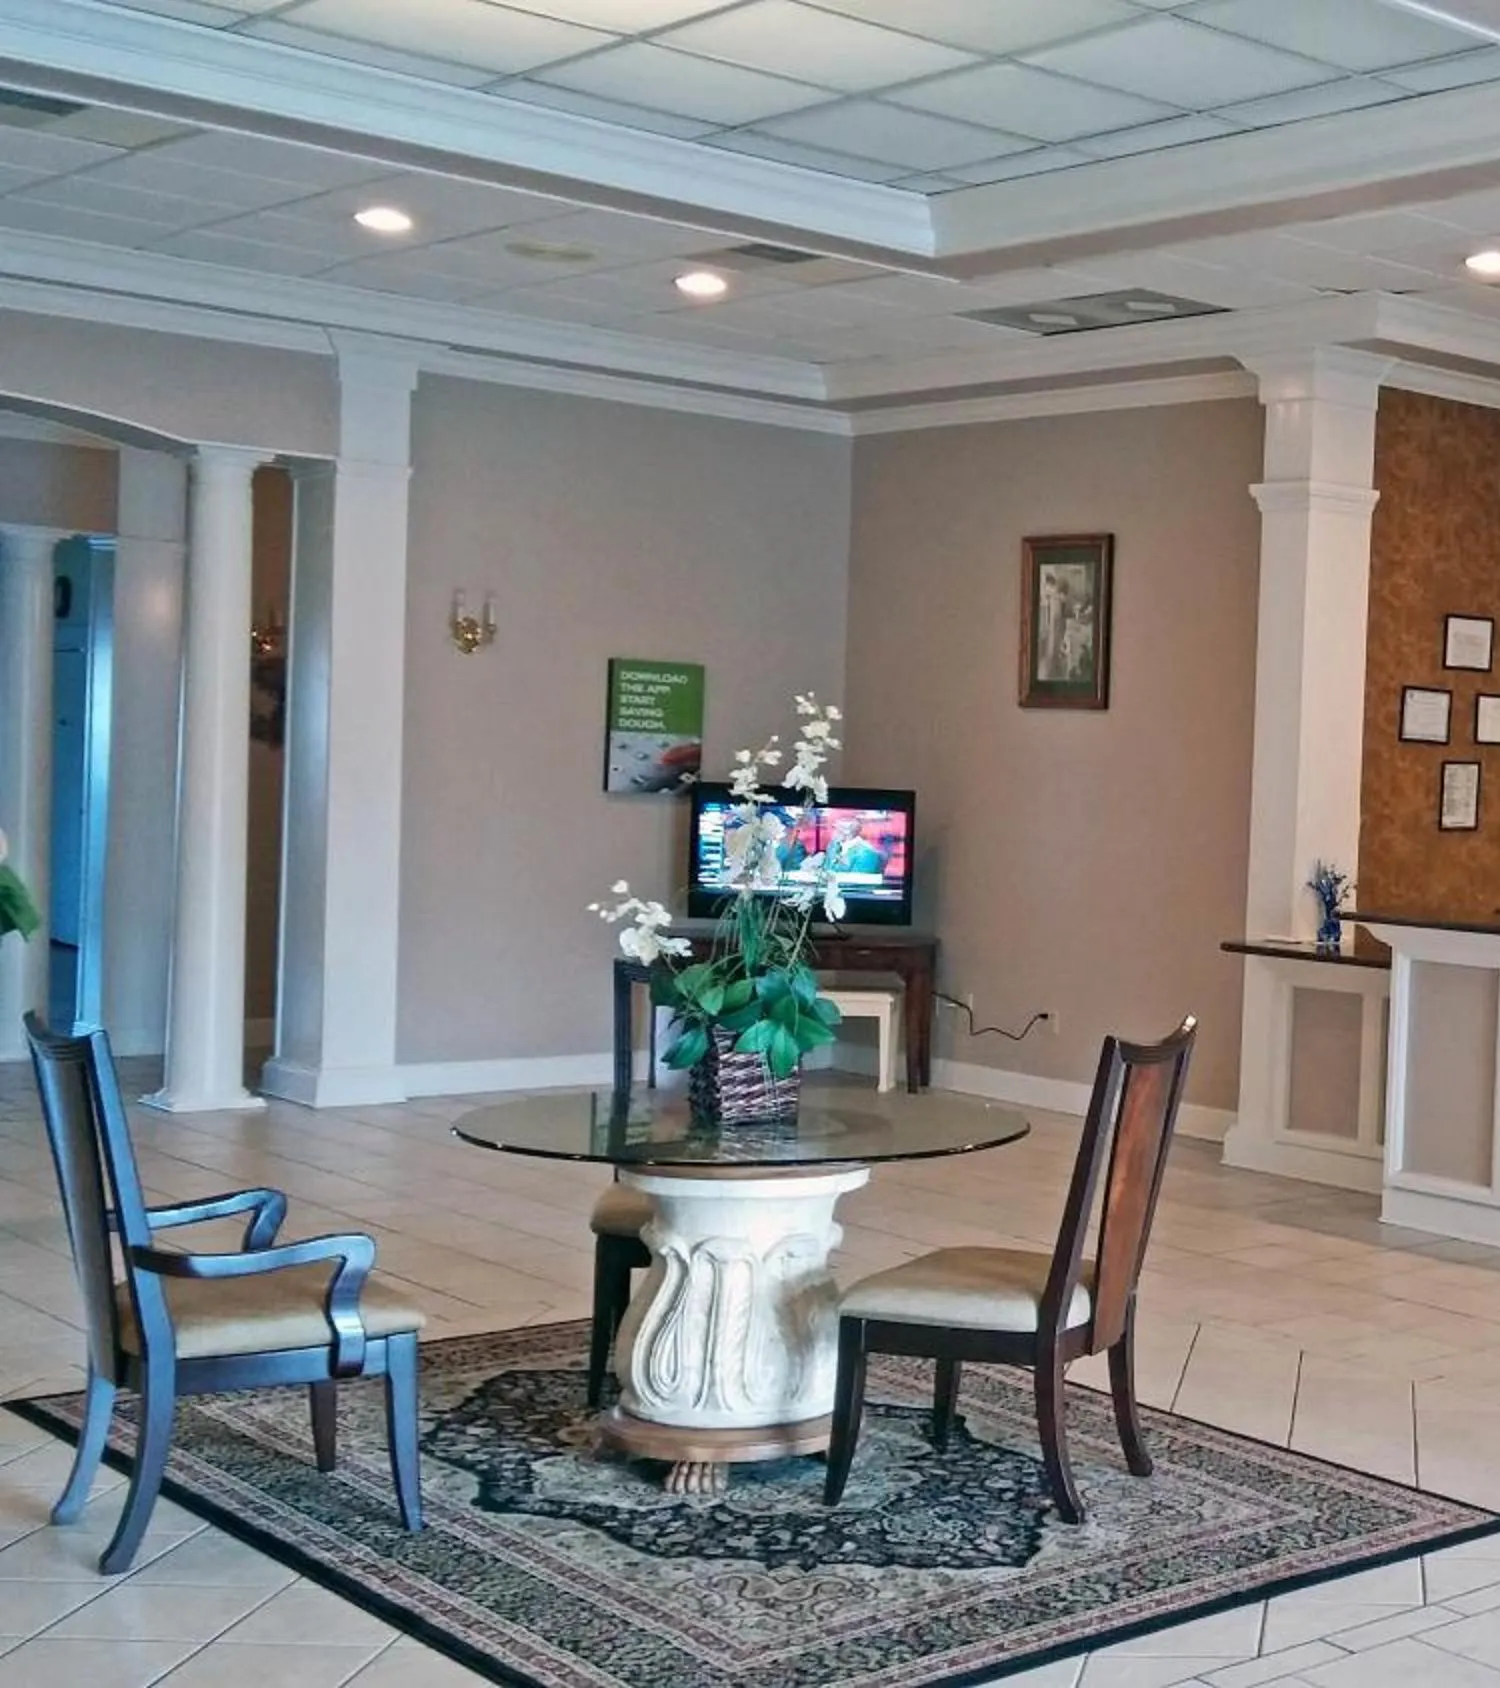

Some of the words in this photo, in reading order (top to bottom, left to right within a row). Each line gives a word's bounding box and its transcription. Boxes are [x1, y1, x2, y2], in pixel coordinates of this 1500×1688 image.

[620, 671, 688, 685] DOWNLOAD
[620, 683, 644, 693] THE
[620, 695, 656, 706] START
[619, 706, 664, 718] SAVING
